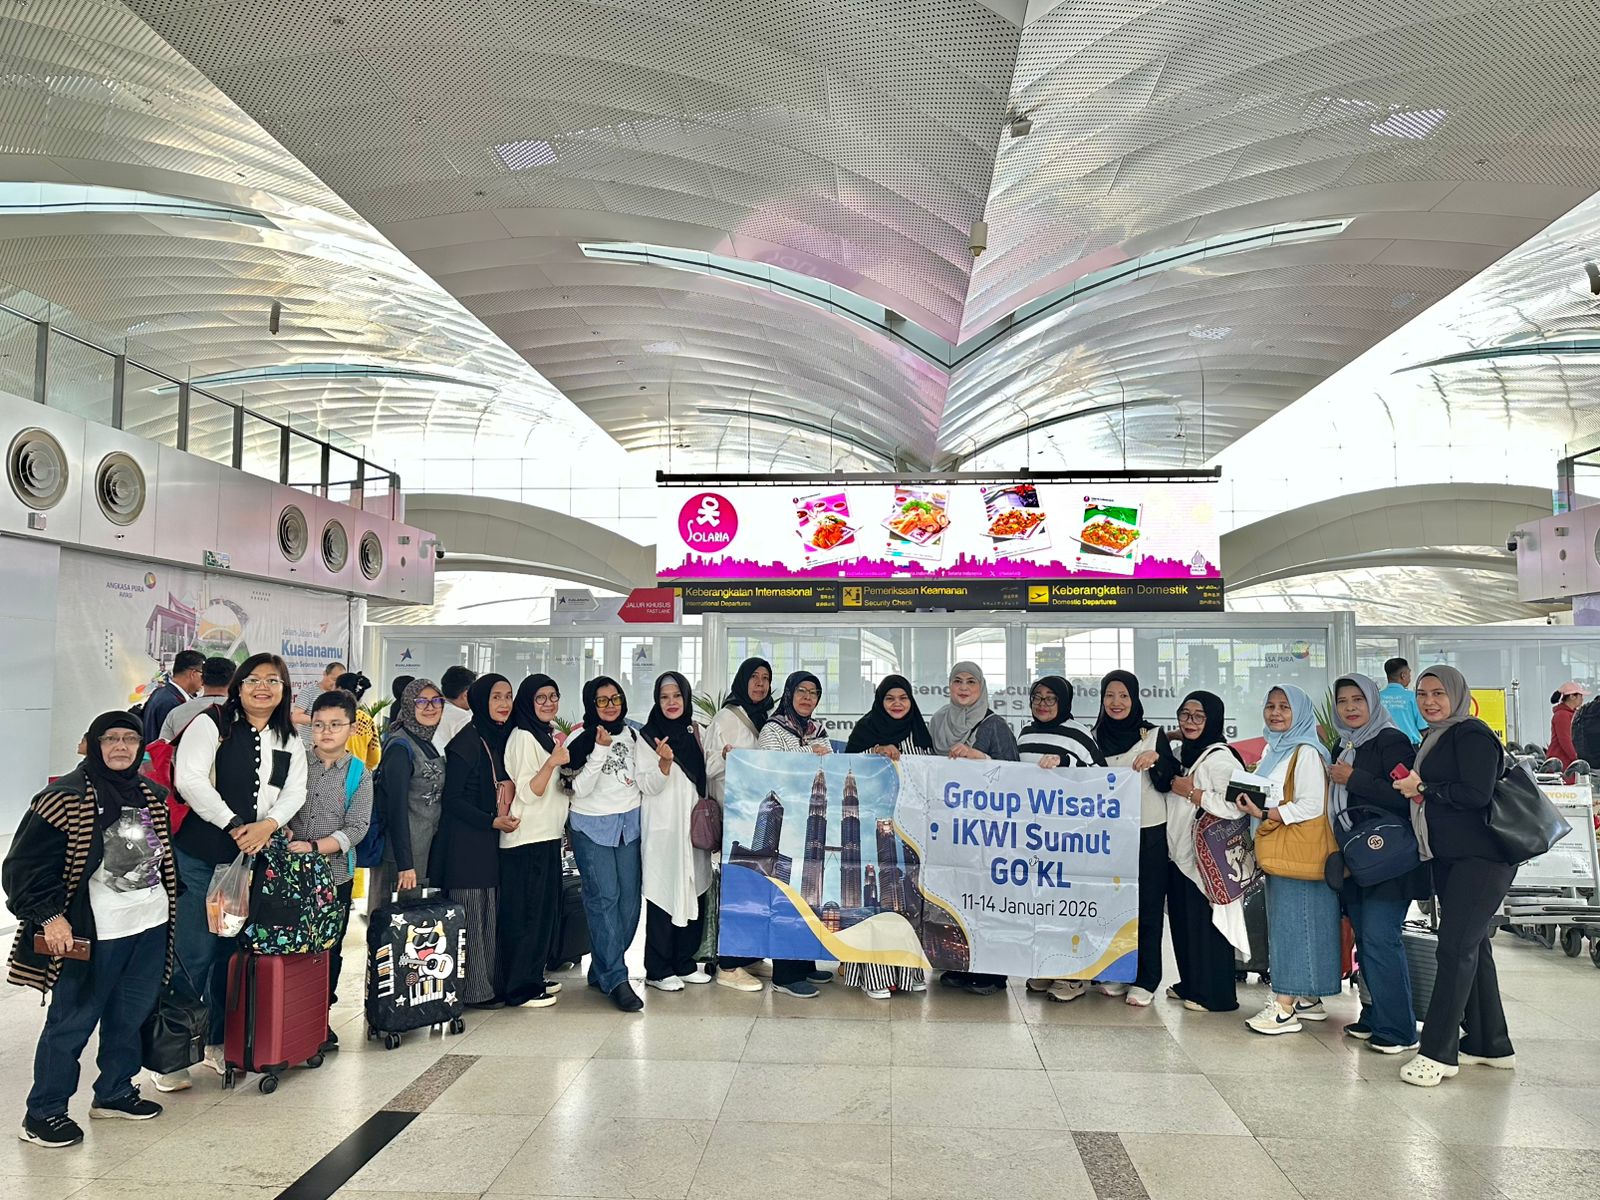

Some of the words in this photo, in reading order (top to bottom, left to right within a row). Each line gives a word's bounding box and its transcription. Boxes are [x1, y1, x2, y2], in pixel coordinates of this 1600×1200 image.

[687, 519, 730, 543] SOLARIA
[106, 581, 131, 591] ANGKASA
[131, 585, 145, 593] PURA
[685, 587, 754, 599] Keberangkatan
[755, 586, 813, 597] Internasional
[863, 586, 919, 595] Pemeriksaan
[920, 585, 968, 596] Keamanan
[1052, 585, 1134, 597] Keberangkatan
[1137, 585, 1189, 595] Domestik
[625, 601, 645, 609] JALUR
[645, 601, 672, 609] KHUSUS
[864, 599, 891, 607] Security
[1052, 598, 1082, 606] Domestic
[1082, 598, 1117, 606] Departures
[281, 639, 343, 659] Kualanamu
[1140, 685, 1176, 698] oint
[943, 781, 1021, 818] Group
[1027, 787, 1121, 819] Wisata
[952, 817, 1017, 849] IKWI
[1025, 822, 1111, 855] Sumut
[990, 856, 1029, 886] GO
[1037, 861, 1072, 888] KL
[961, 893, 996, 913] 11-14
[998, 896, 1055, 916] Januari
[1058, 899, 1098, 918] 2026
